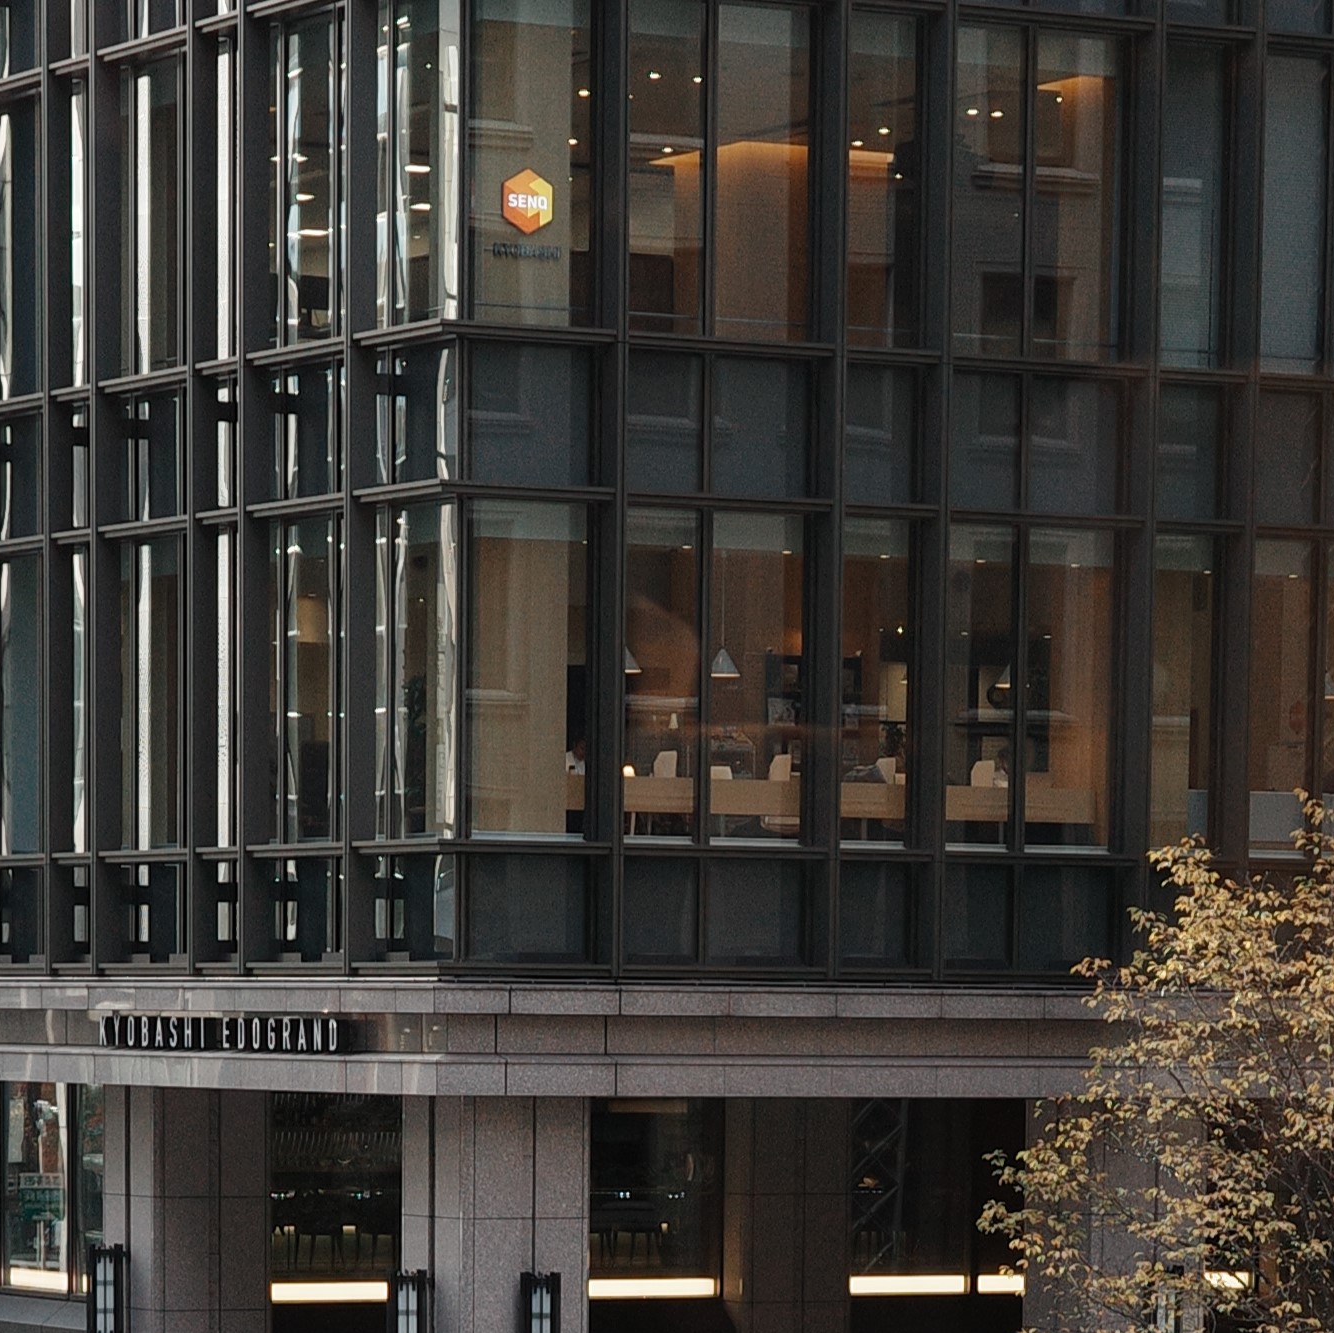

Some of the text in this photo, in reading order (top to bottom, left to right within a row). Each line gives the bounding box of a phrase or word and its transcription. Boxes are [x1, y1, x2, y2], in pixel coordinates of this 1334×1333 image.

[507, 193, 548, 211] SENQ
[99, 1015, 338, 1052] KYOBASHI EDOGRAND
